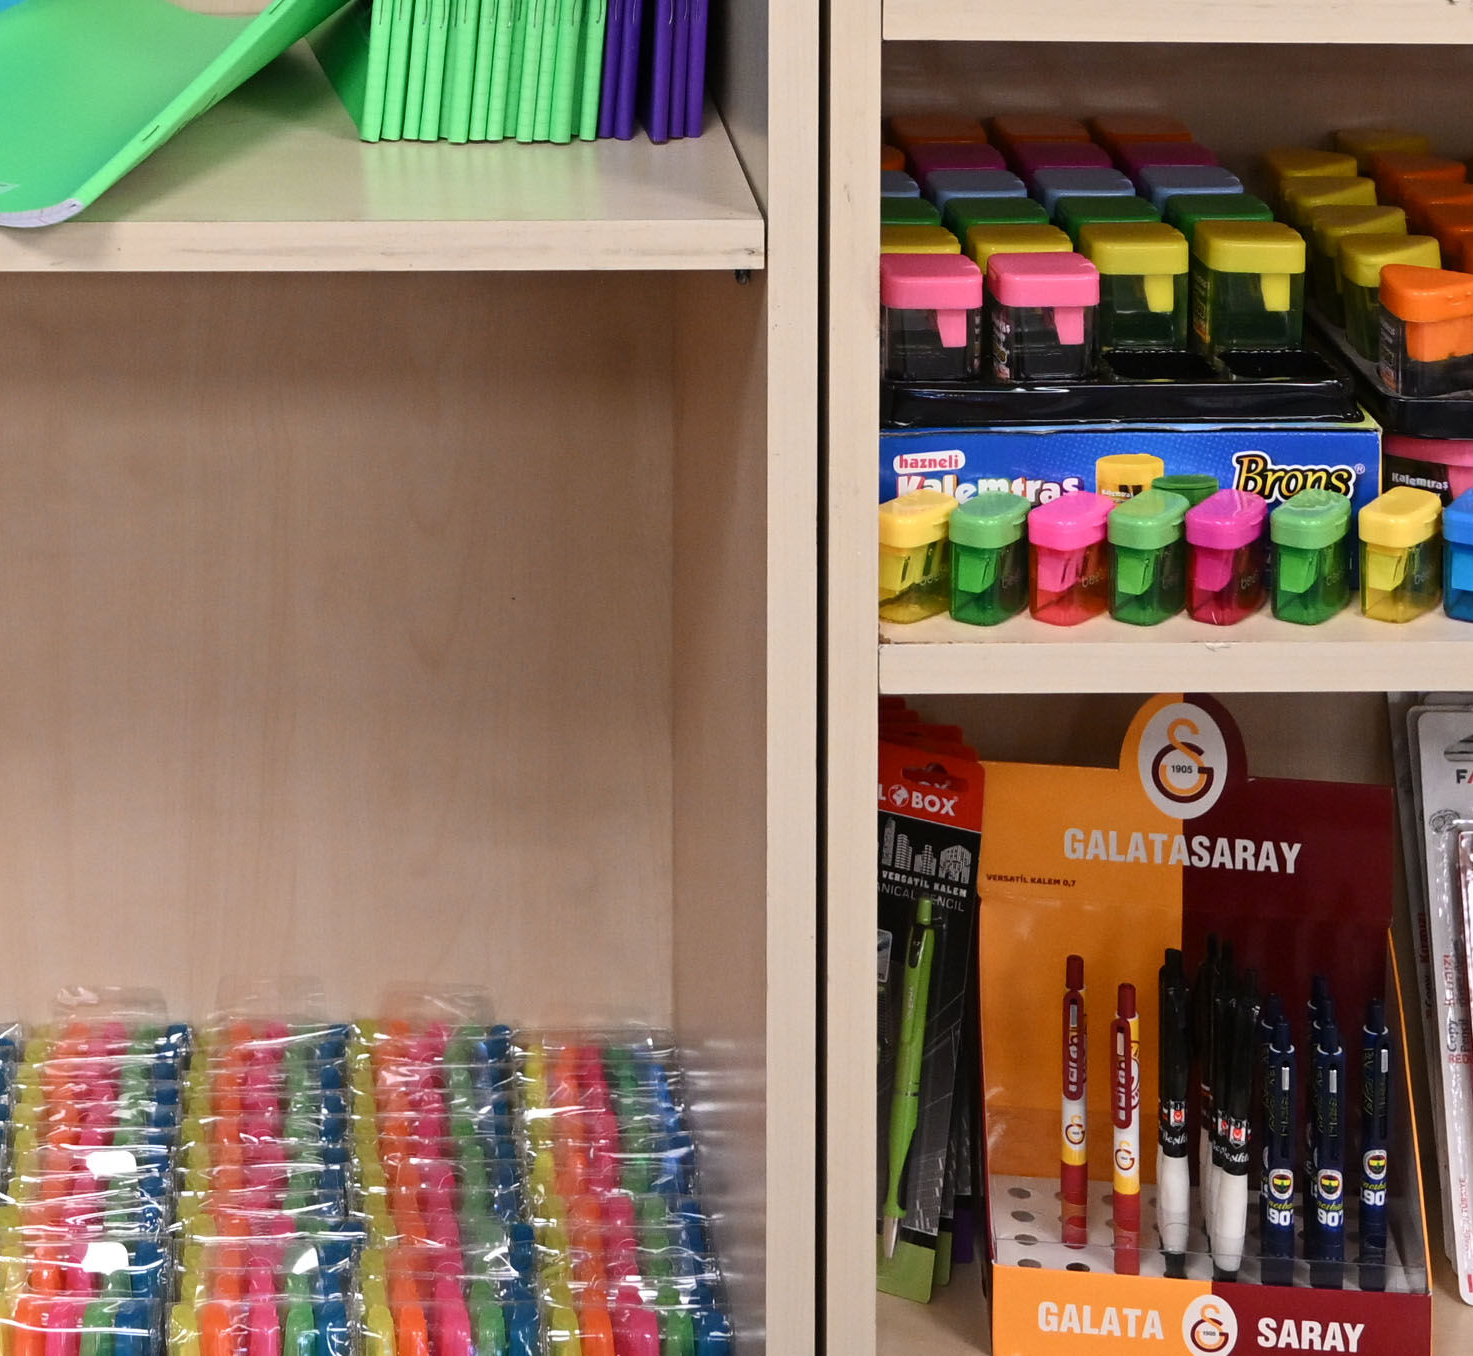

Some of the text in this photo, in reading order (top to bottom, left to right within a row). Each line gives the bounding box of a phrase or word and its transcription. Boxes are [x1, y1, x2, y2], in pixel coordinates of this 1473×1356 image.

[899, 454, 960, 471] hazneli
[1236, 452, 1351, 501] Brons
[1171, 764, 1193, 774] 1905
[1063, 827, 1302, 874] GALATASARAY
[882, 870, 967, 897] VERSATİL KALEM
[986, 873, 1076, 887] VERSATİL KALEM 0,7
[1037, 1301, 1164, 1340] GALATA
[1257, 1317, 1365, 1352] SARAY
